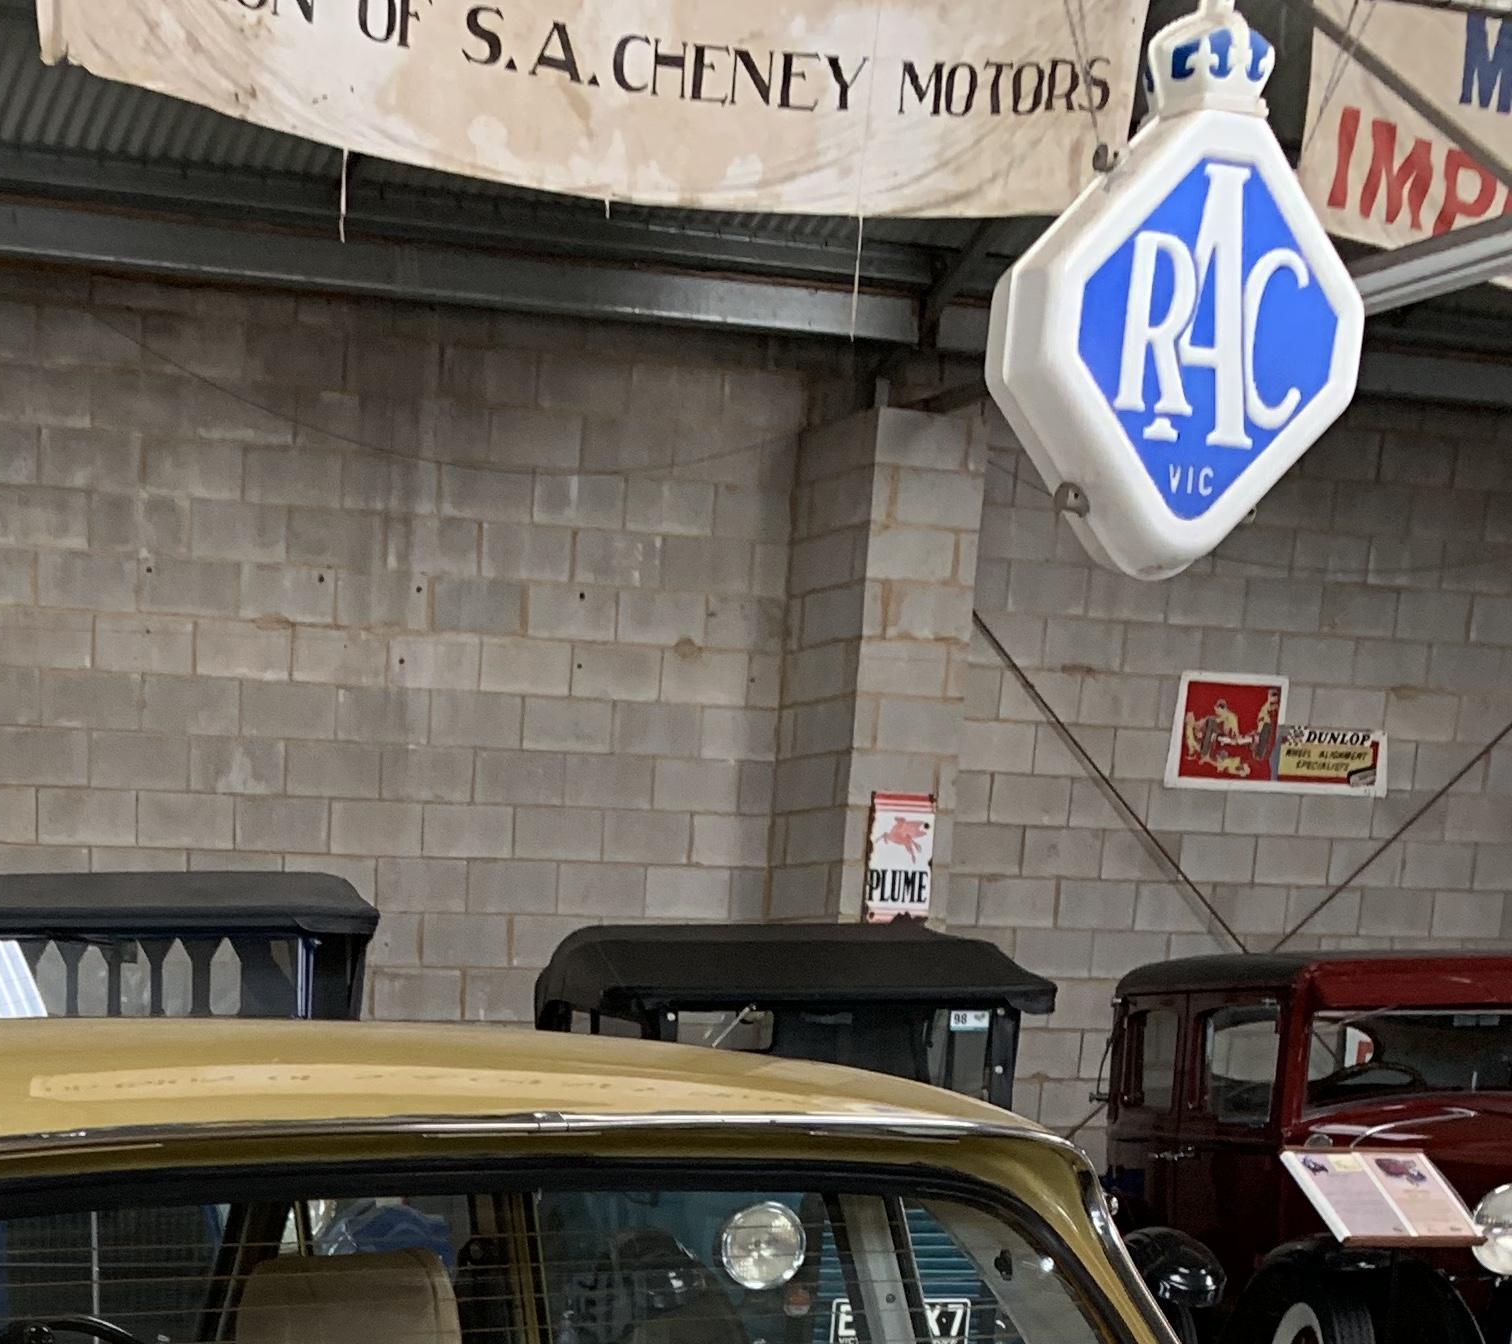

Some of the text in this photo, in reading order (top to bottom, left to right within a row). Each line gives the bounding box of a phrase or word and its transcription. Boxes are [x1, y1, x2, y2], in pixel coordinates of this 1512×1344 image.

[898, 56, 1111, 117] MOTORS
[1326, 105, 1512, 238] IMP
[1168, 463, 1214, 498] VIC
[1305, 731, 1371, 746] DUNLOP
[868, 869, 928, 903] PLUME
